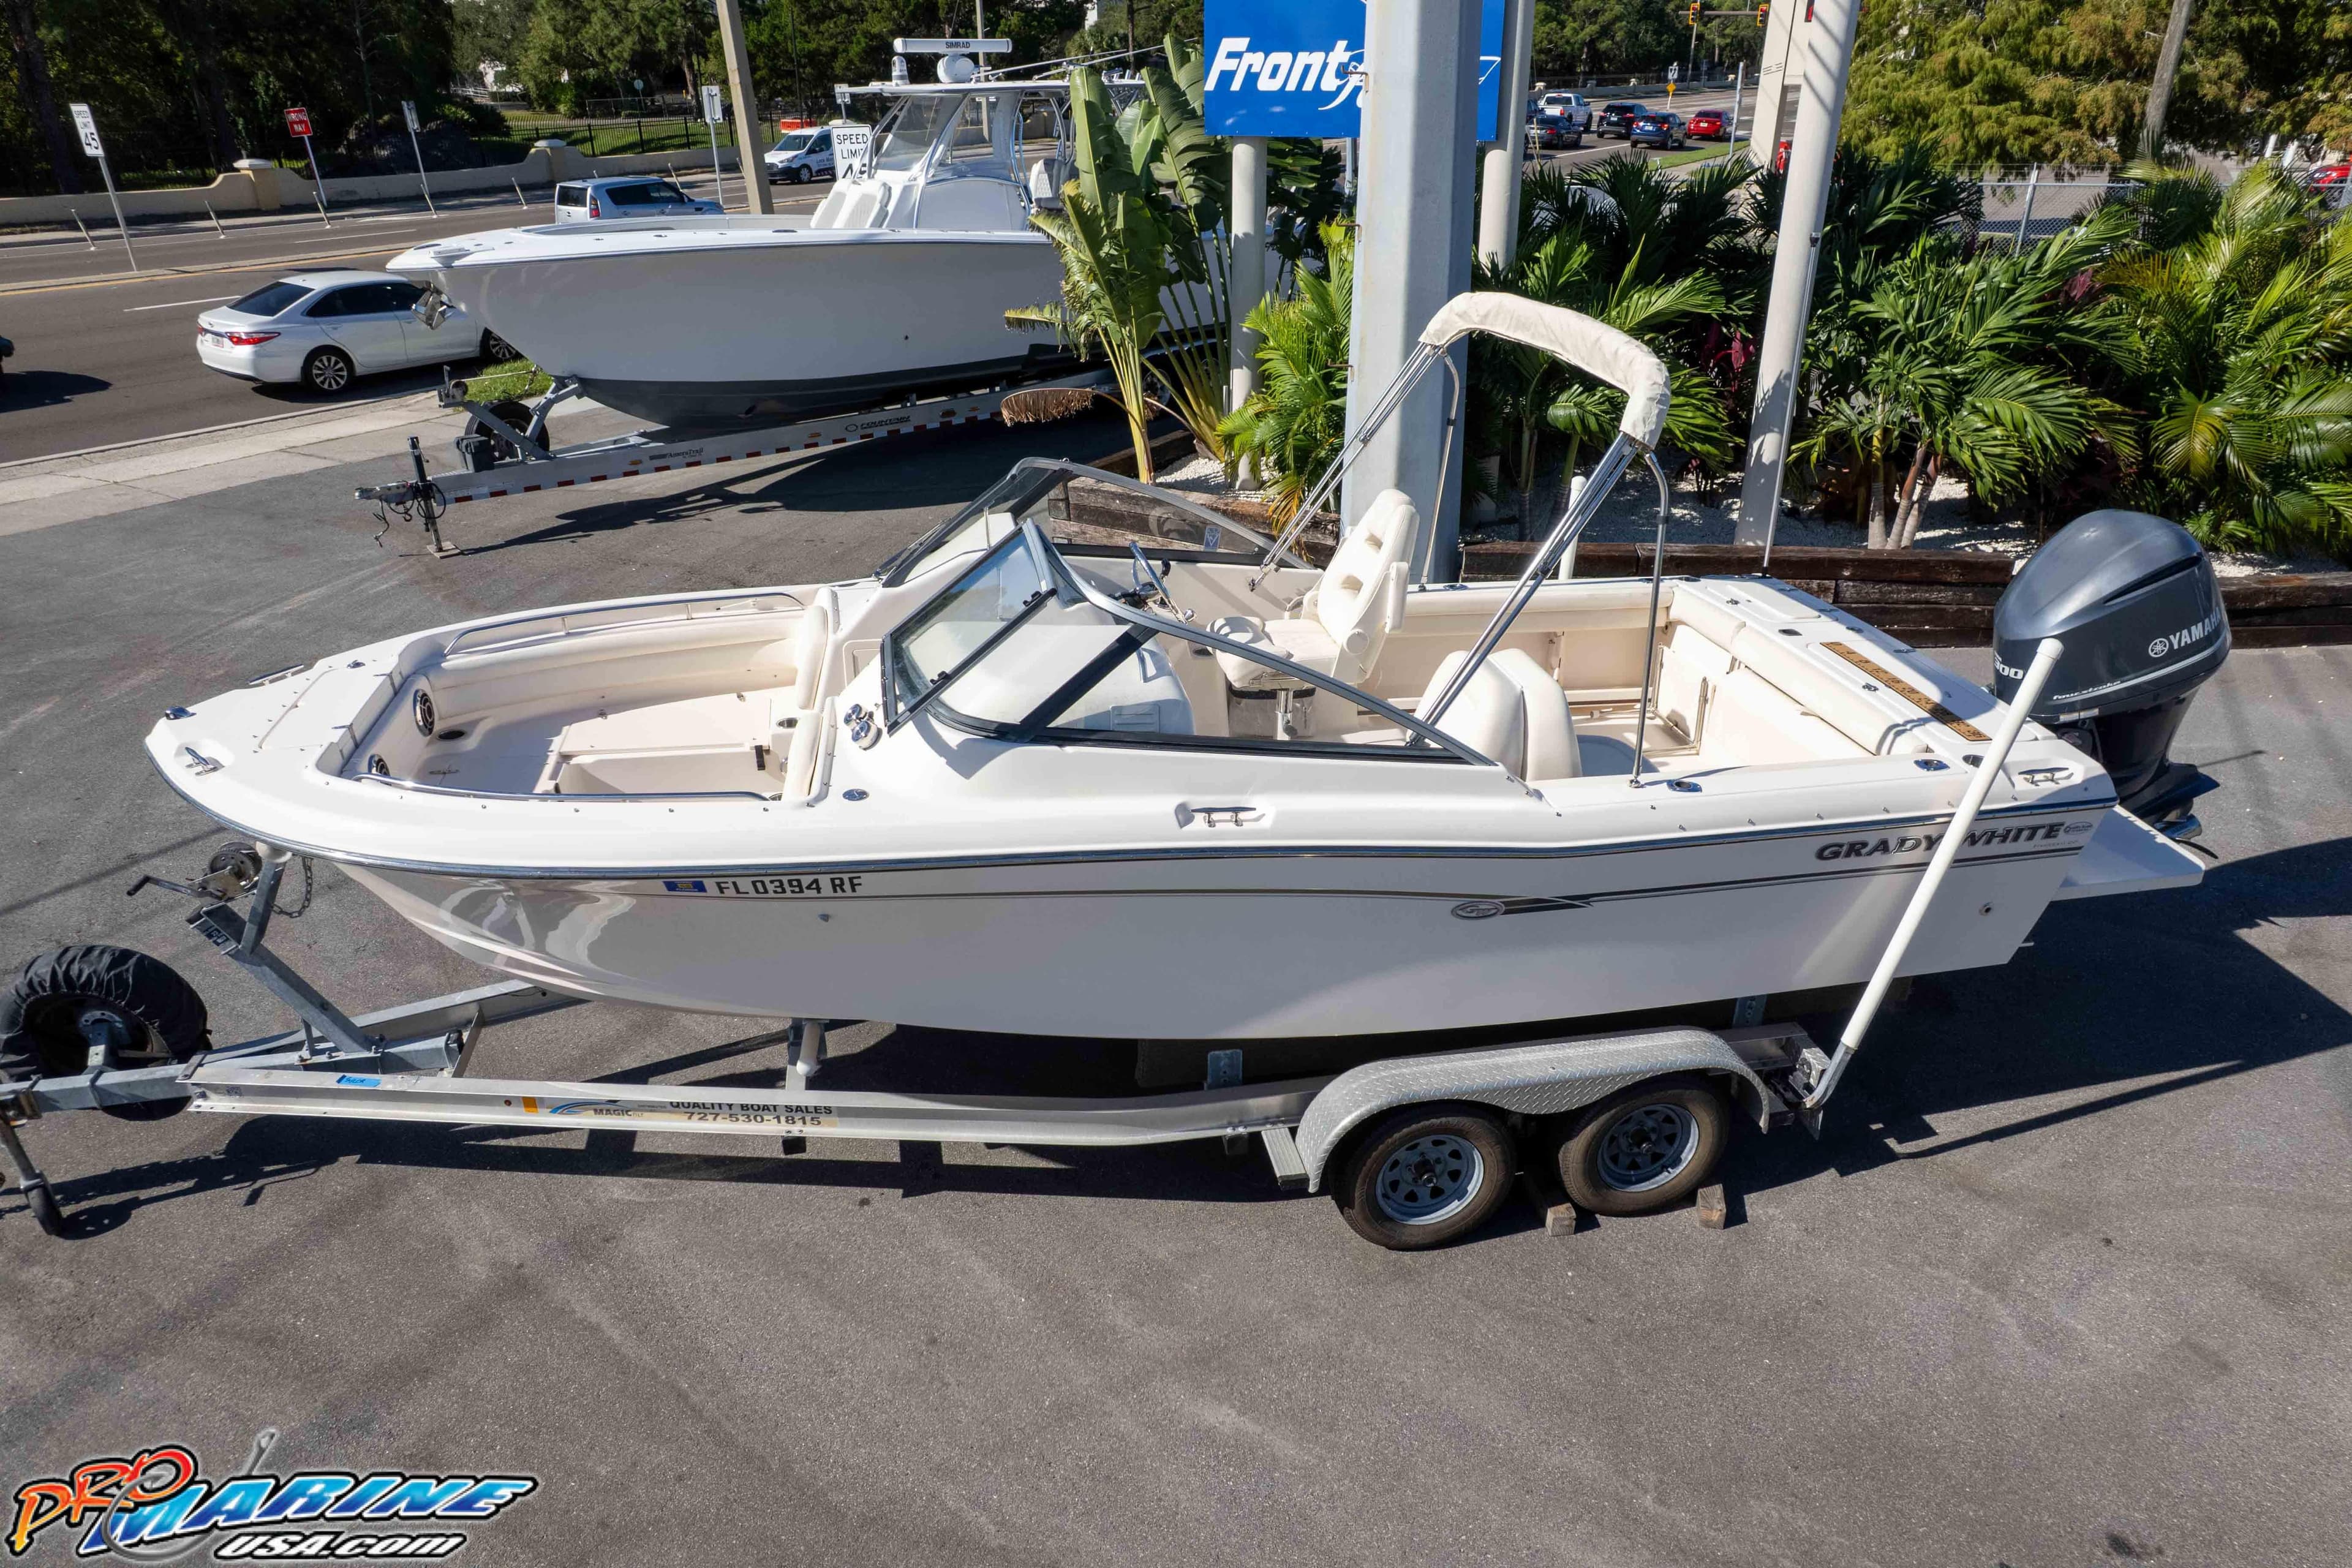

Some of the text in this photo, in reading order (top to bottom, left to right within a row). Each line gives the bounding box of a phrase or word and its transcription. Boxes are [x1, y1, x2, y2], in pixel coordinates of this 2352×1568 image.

[287, 113, 307, 122] WRONG
[293, 124, 306, 133] WAY
[85, 132, 99, 149] 45
[836, 134, 869, 145] SPEED
[2169, 607, 2221, 650] YAMAHA
[1815, 832, 1945, 861] GRADY
[829, 876, 862, 894] RF
[592, 1107, 631, 1117] MAGIC
[669, 1102, 832, 1115] QUALITY BOAT SALES
[684, 1111, 822, 1126] 727-530-1815
